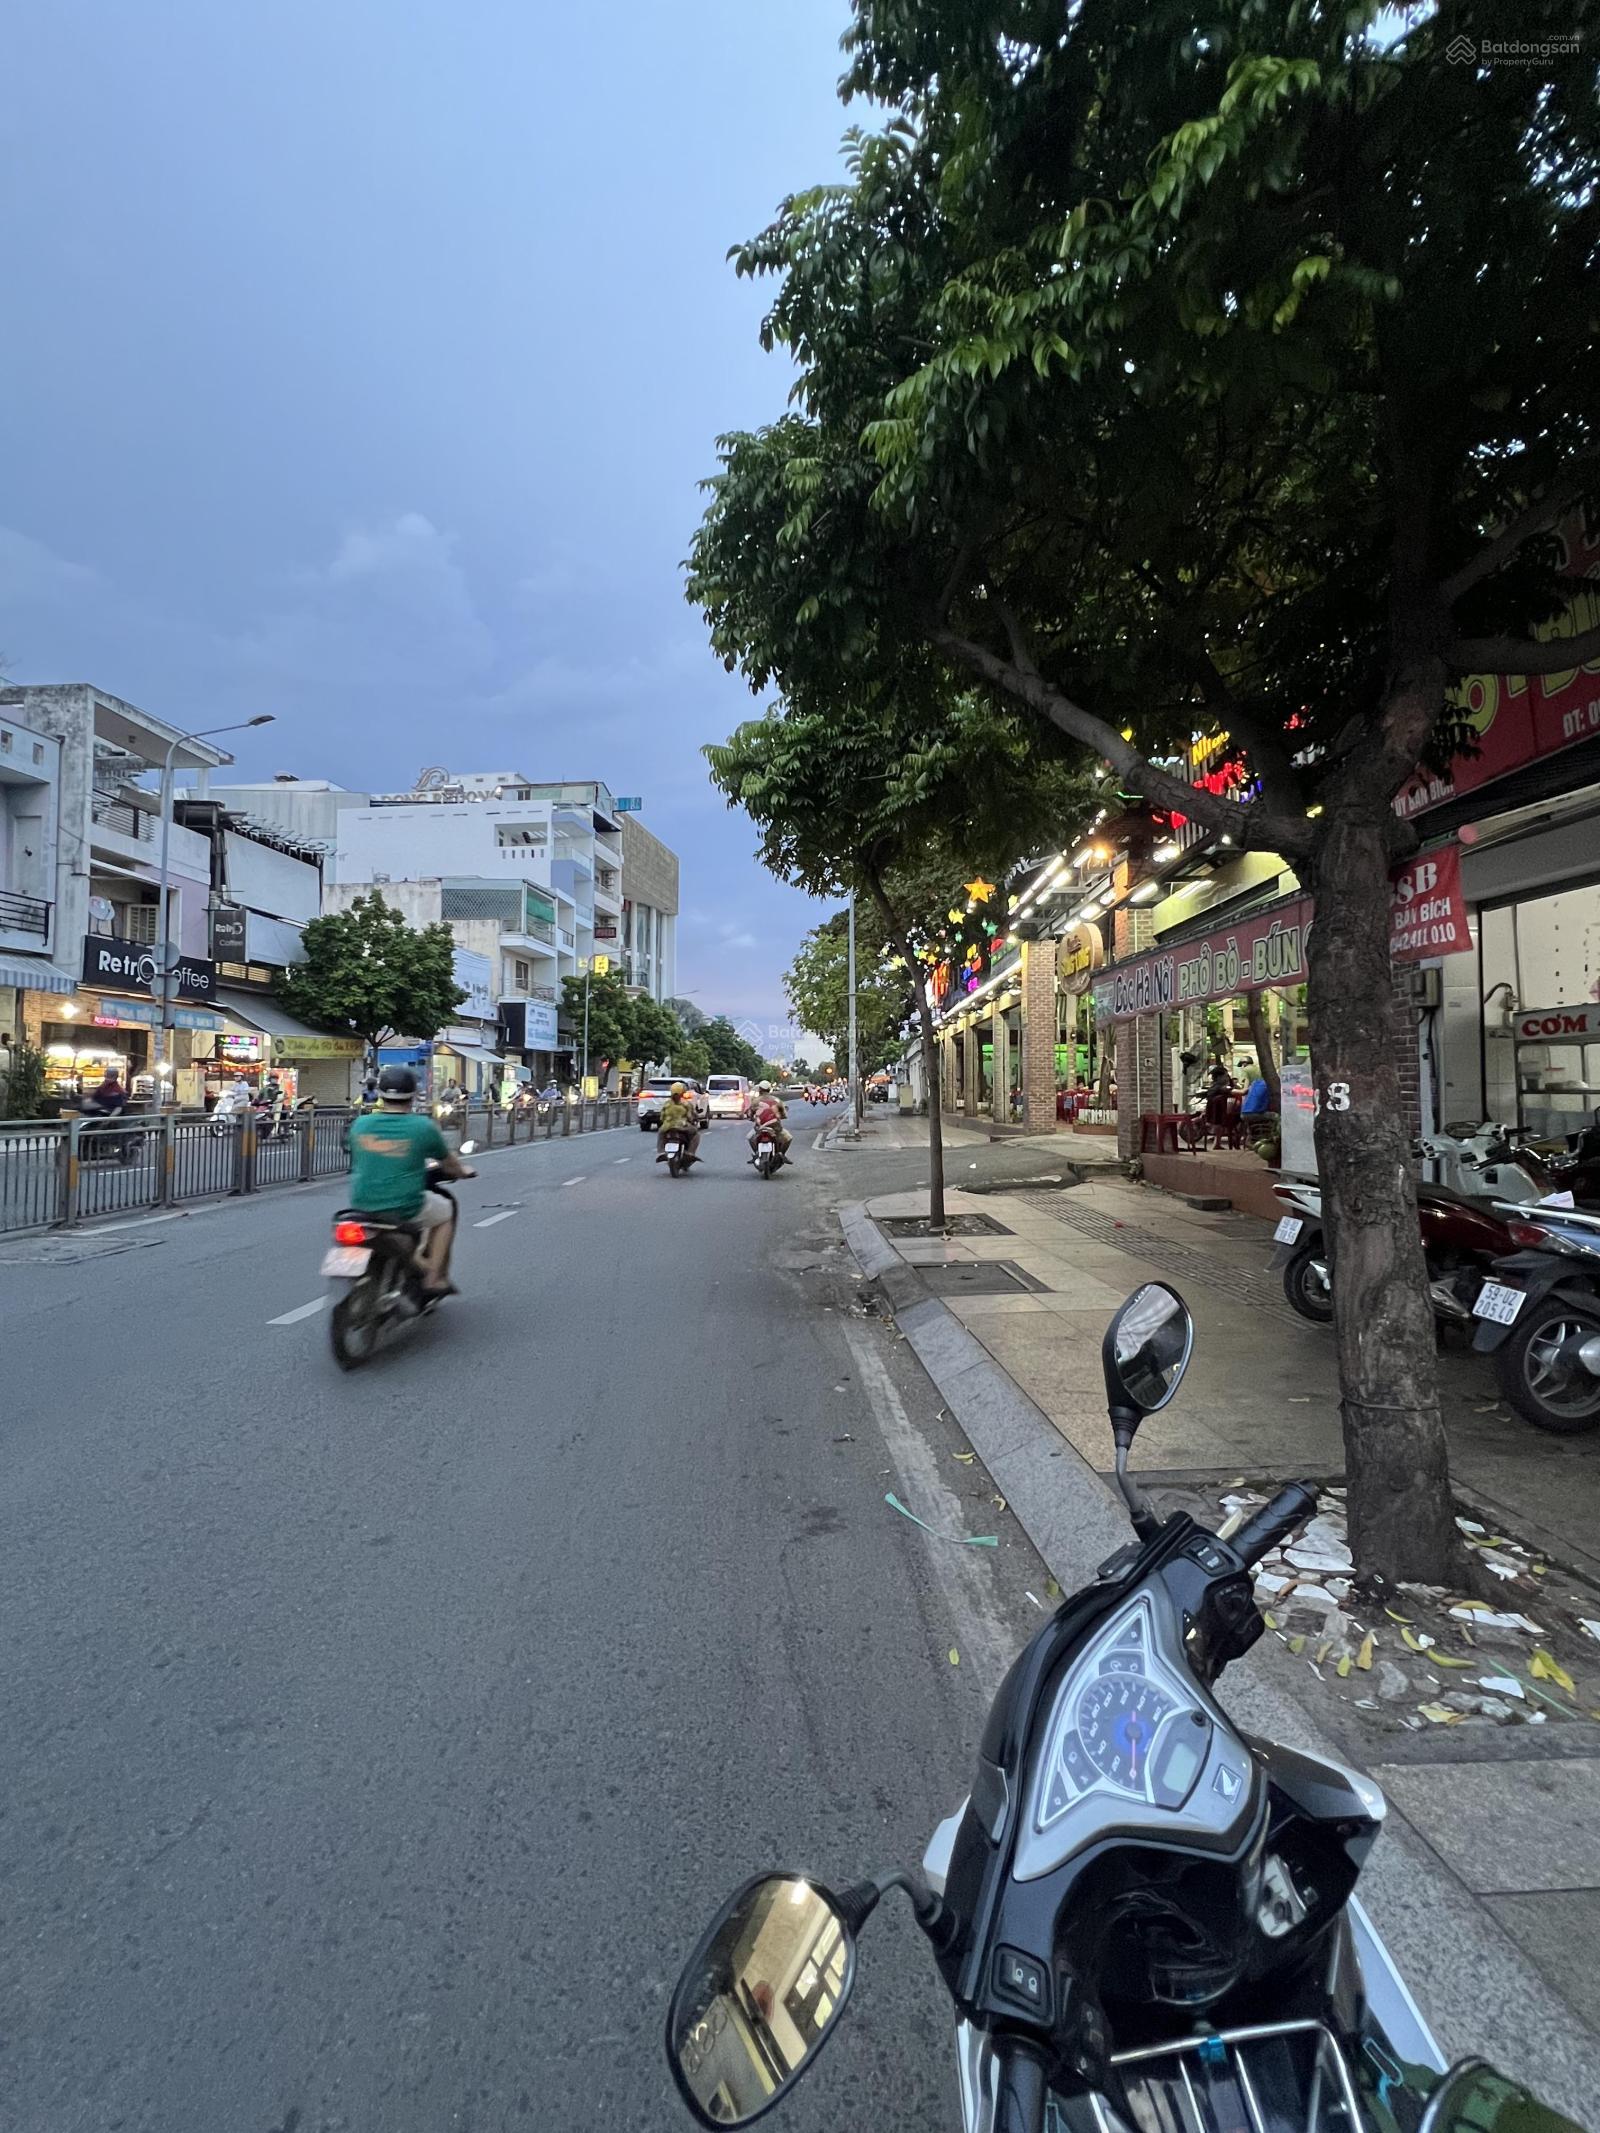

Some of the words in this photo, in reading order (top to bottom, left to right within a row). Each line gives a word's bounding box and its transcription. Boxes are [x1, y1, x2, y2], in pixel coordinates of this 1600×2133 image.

[1420, 896, 1452, 922] BÍCH
[1431, 922, 1457, 944] 010
[1135, 962, 1151, 1010] Hà
[1153, 955, 1175, 1010] Nội
[1213, 936, 1240, 993] BÒ
[1253, 920, 1301, 984] BÚN
[171, 967, 210, 989] offee
[1521, 1013, 1588, 1037] CƠM
